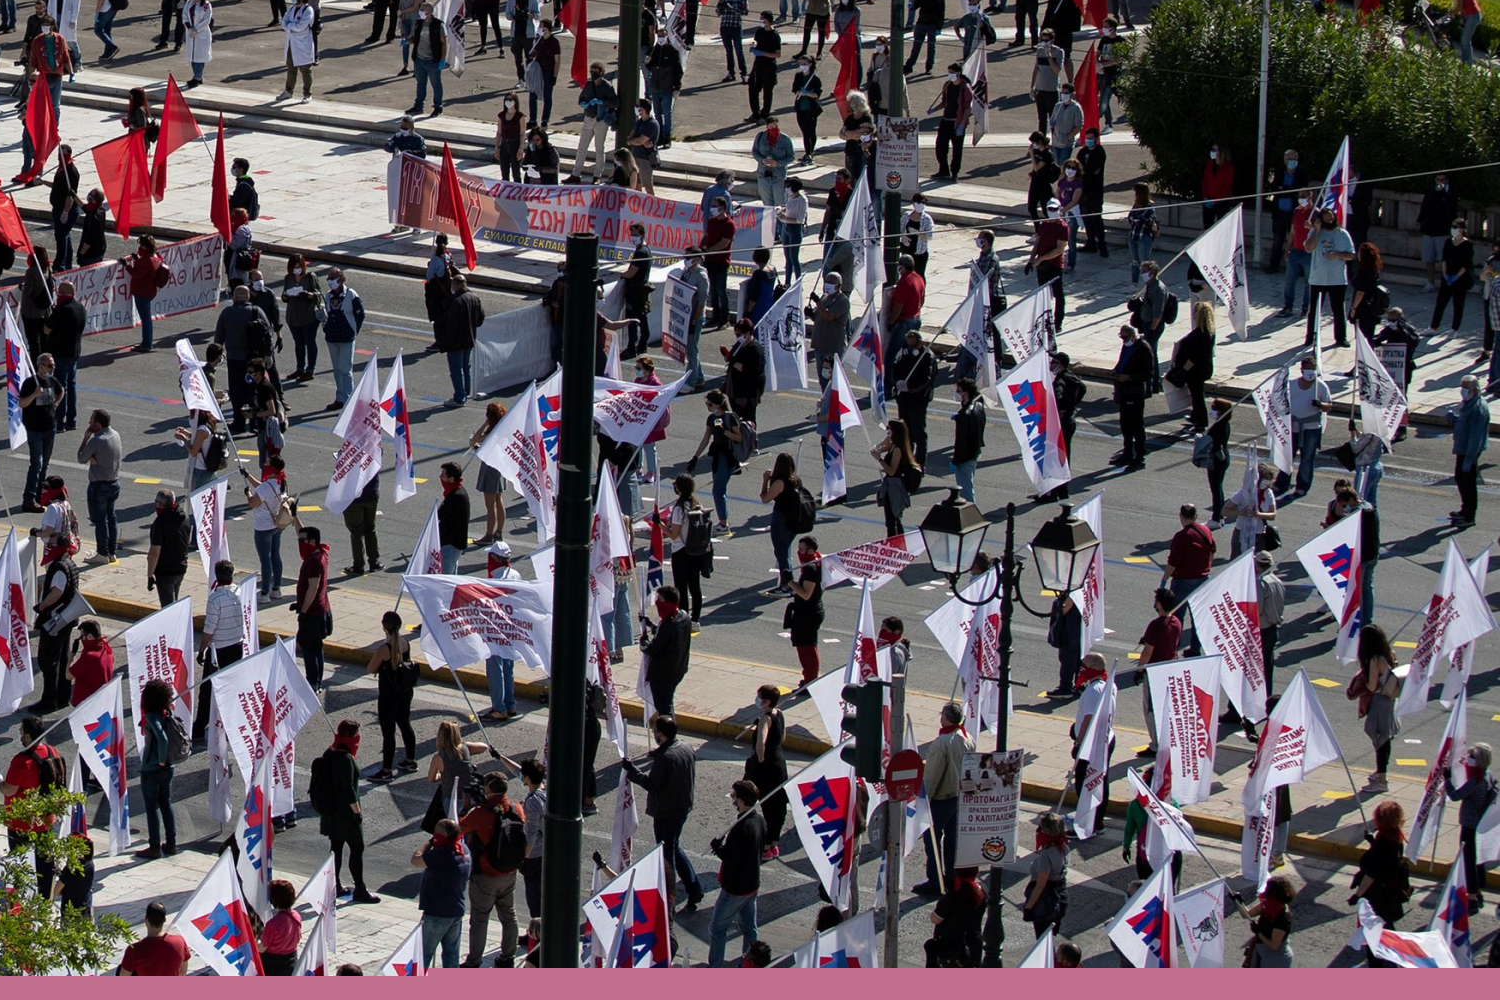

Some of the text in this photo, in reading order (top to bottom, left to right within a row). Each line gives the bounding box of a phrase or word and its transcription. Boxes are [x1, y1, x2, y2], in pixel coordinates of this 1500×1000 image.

[486, 182, 557, 205] ΑΓΩΝΑΣ
[557, 187, 585, 208] ΓΙΑ
[591, 187, 676, 220] ΜΟΡΦΩΣΗ
[483, 229, 530, 246] ΣΥΛΛΟΓΟΣ
[532, 239, 567, 252] ΕΚΠΑΙΔ
[528, 208, 566, 234] ΖΩΗ
[570, 212, 597, 235] ΜΕ
[439, 608, 480, 623] ΣΩΜΑΤΕΙΟ
[1209, 604, 1232, 643] ΣΥΝΑΦΩΝ
[159, 634, 171, 677] ΣΩΜΑΤΕΙΟ
[1168, 675, 1180, 716] ΣΥΝΑΦΩΝ
[1183, 669, 1195, 714] ΣΩΜΑΤΕΙΟ
[962, 793, 1010, 804] ΠΡΩΤΟΜΑΓΙΑ
